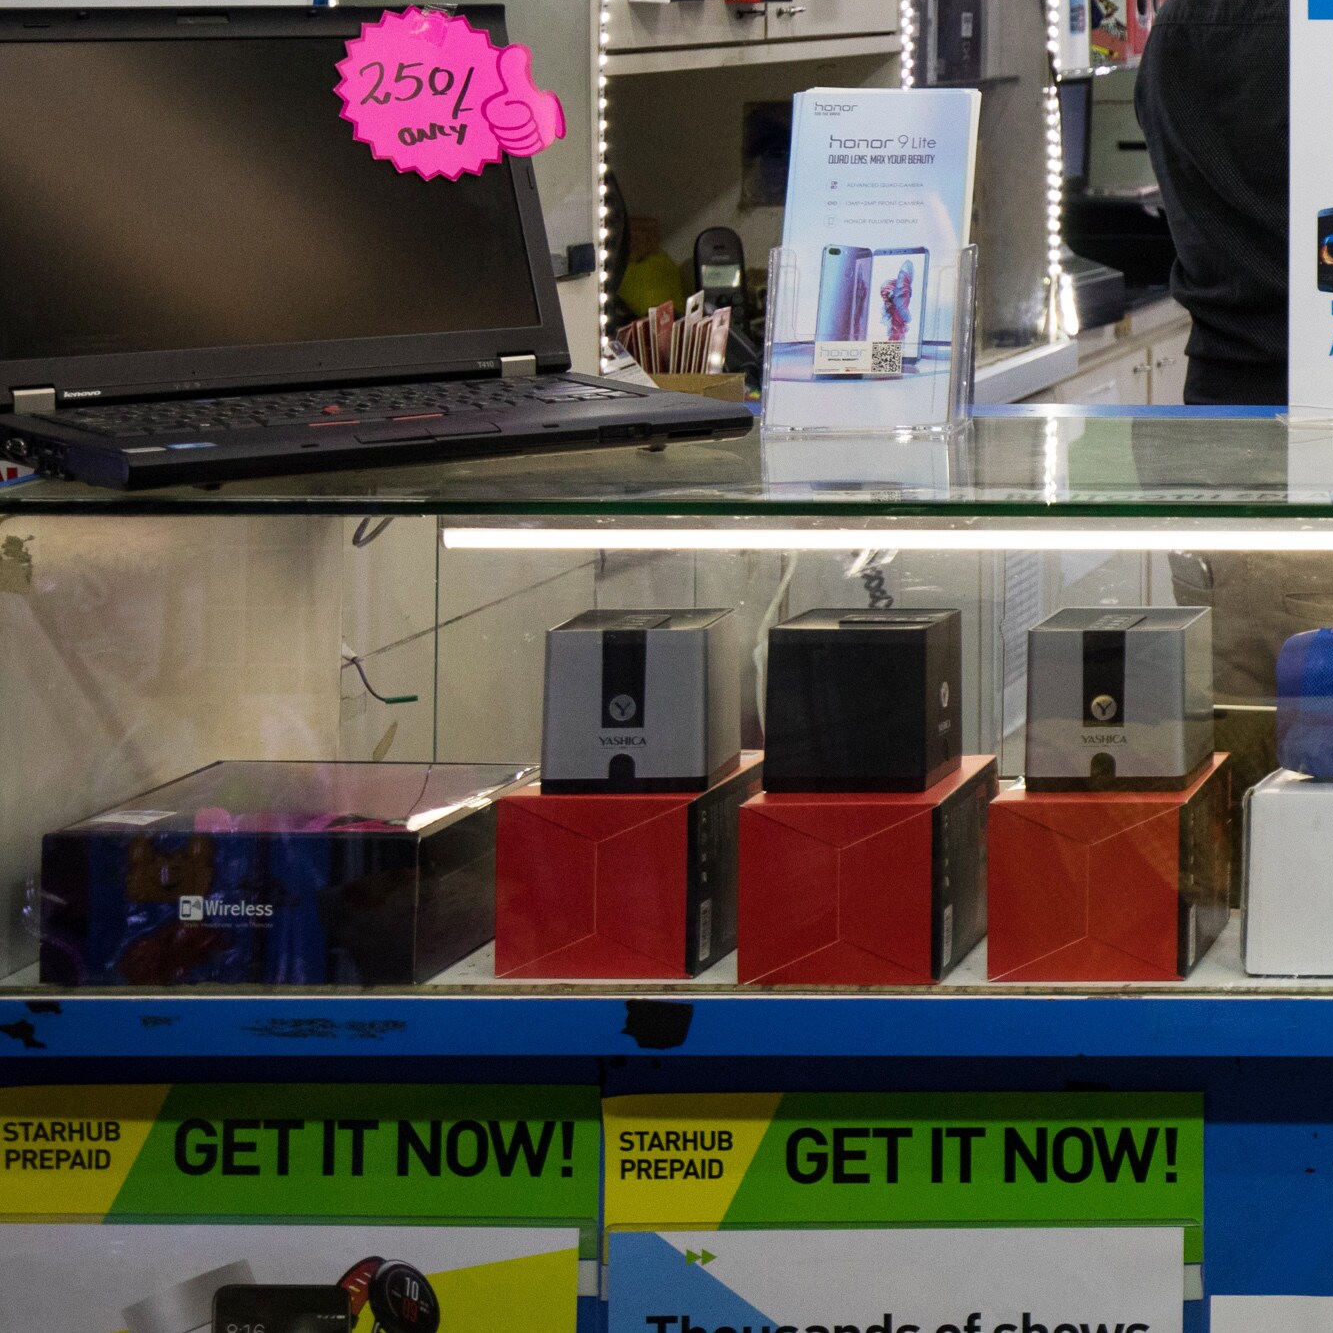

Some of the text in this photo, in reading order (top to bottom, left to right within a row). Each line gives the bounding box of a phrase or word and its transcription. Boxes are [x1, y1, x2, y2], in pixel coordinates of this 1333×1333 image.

[814, 101, 858, 112] honor
[829, 134, 937, 150] honor Lite
[828, 154, 935, 165] QUAD YOUR BEAUTY
[819, 345, 867, 358] honor
[62, 389, 101, 399] lenovo
[599, 735, 647, 747] YASHICA
[1080, 733, 1128, 745] YASHICA
[204, 899, 274, 917] Wireless
[3, 1117, 576, 1178] STARHUB GET IT NOW!
[4, 1148, 111, 1171] PREPAID
[619, 1126, 1180, 1186] STARHUB GET IT NOW!
[620, 1158, 724, 1180] PREPAID
